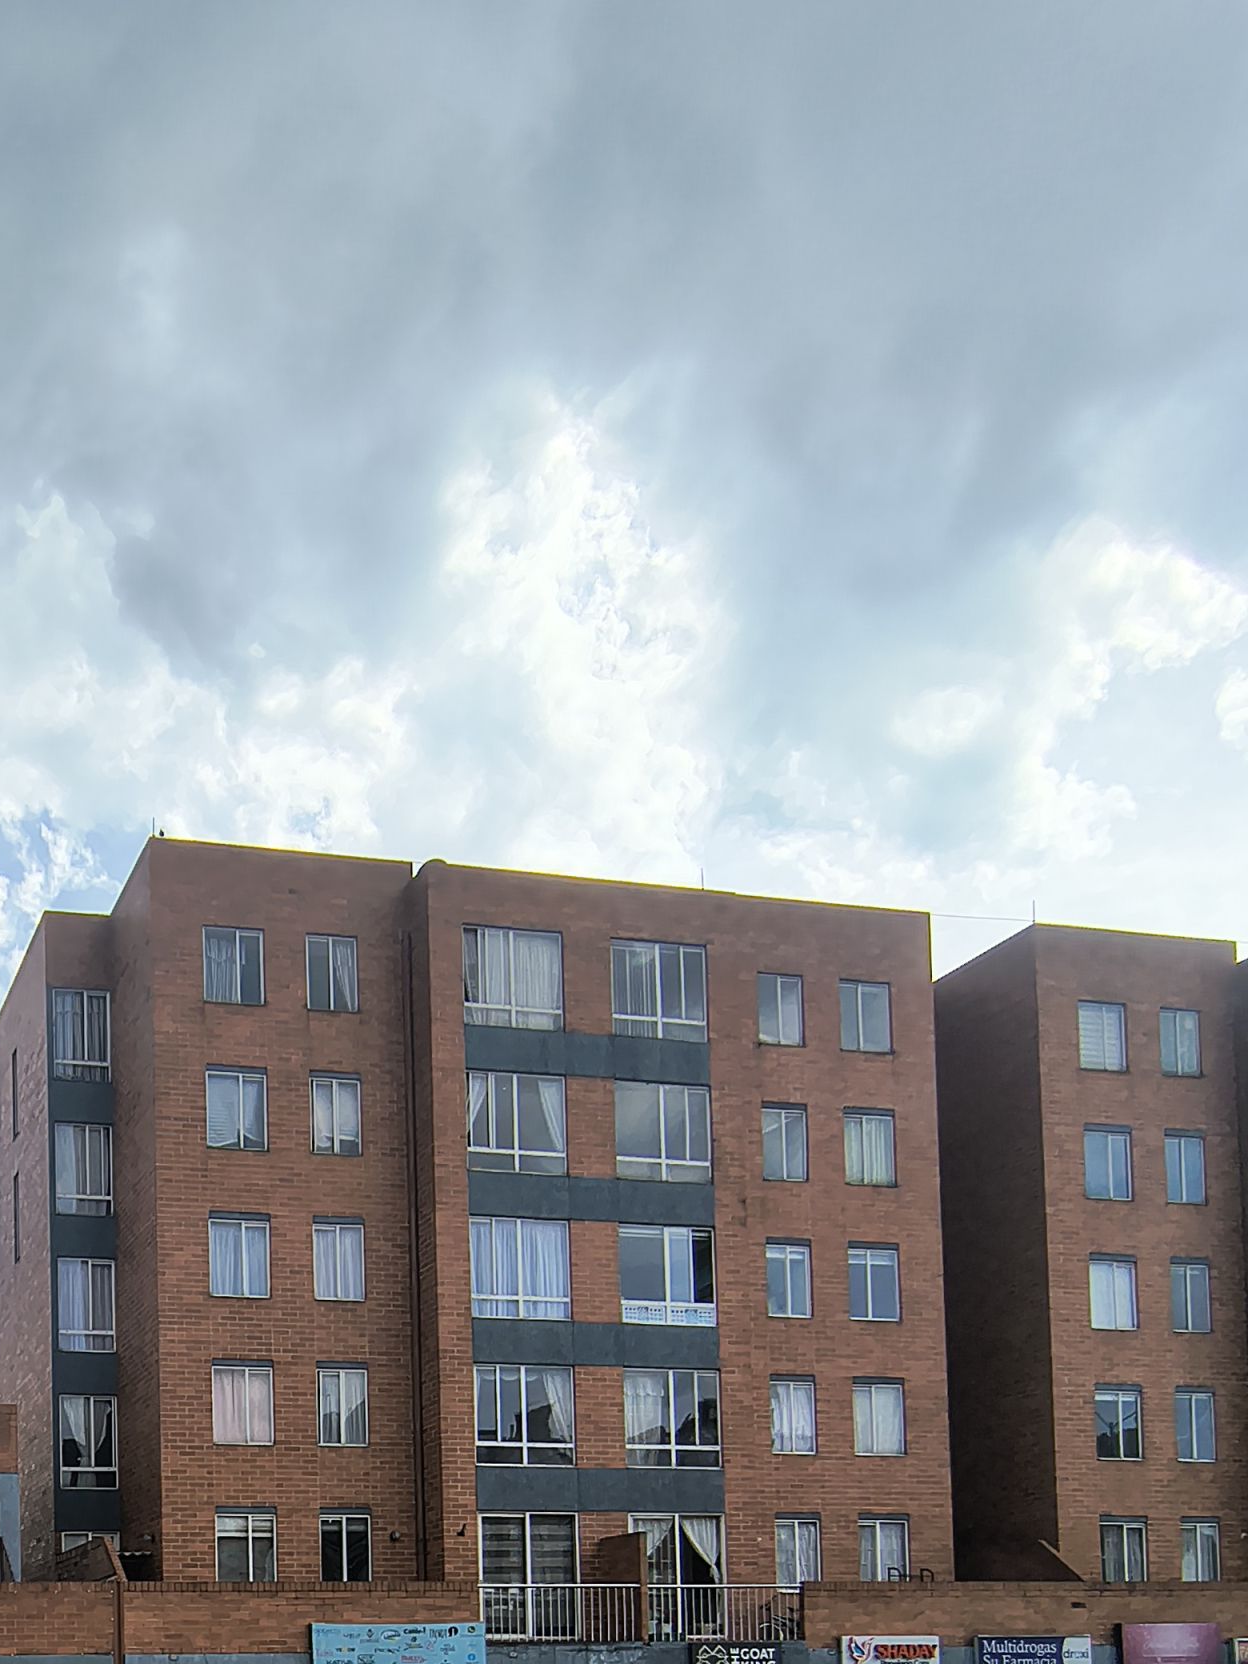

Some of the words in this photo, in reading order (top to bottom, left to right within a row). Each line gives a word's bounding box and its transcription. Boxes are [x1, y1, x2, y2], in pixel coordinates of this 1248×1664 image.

[740, 1648, 775, 1660] GOAT
[873, 1644, 937, 1659] SHADAY
[982, 1640, 1057, 1657] Multidrogas
